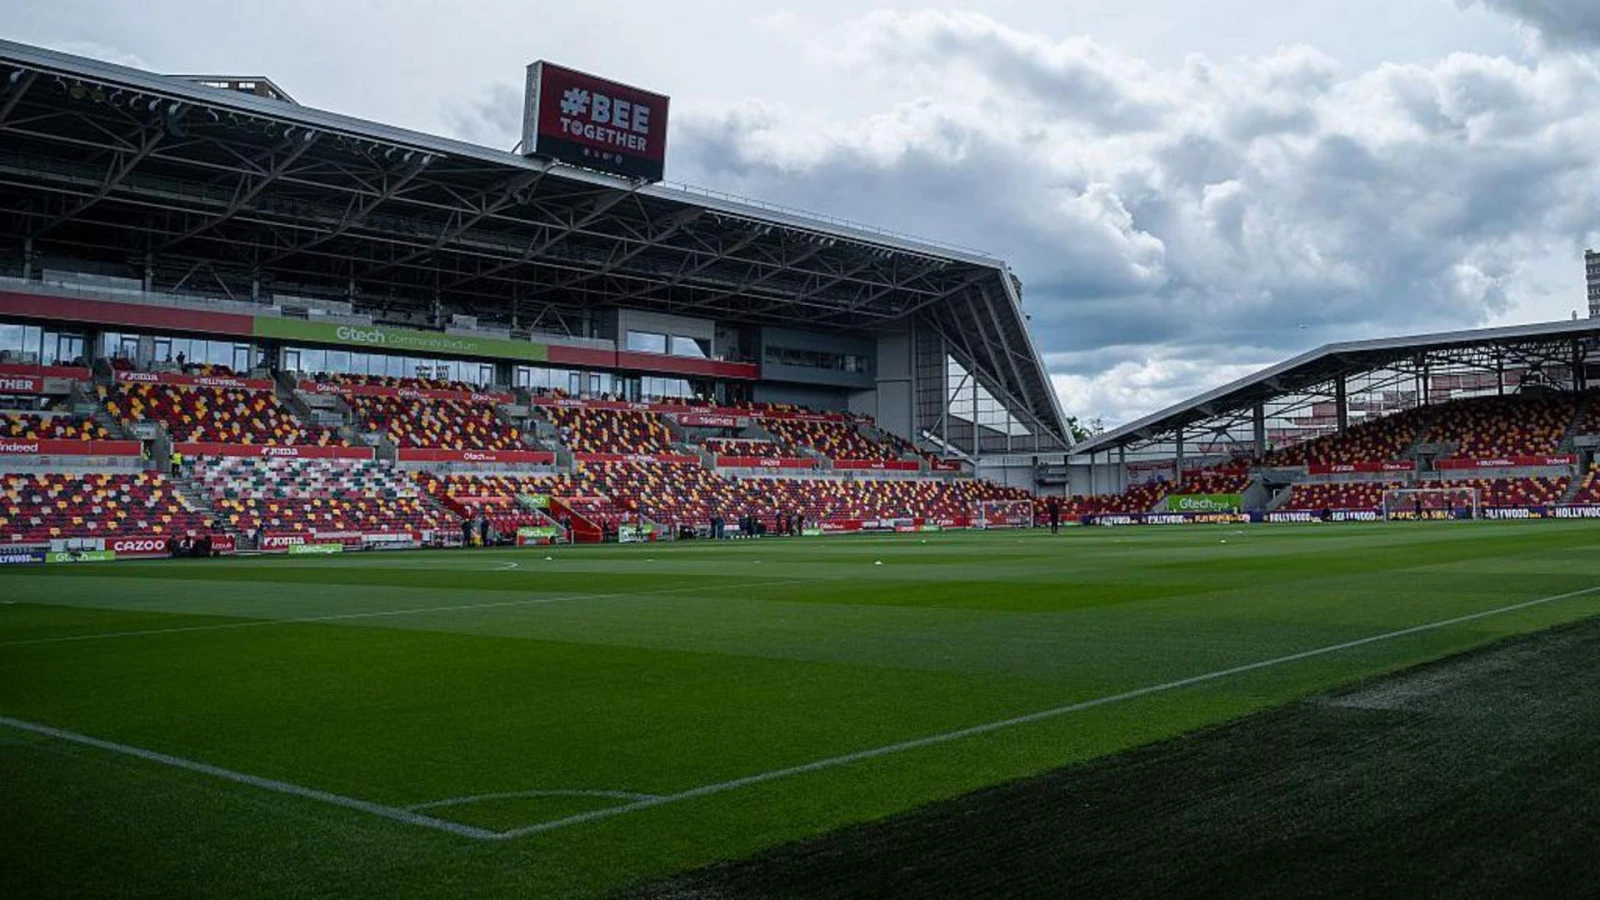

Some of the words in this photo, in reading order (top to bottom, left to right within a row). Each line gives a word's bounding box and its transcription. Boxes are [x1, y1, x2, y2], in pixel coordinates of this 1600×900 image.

[561, 87, 650, 134] #BEE
[560, 116, 647, 151] TOGETHER
[336, 326, 386, 343] Gtech
[114, 540, 165, 551] CAZOO
